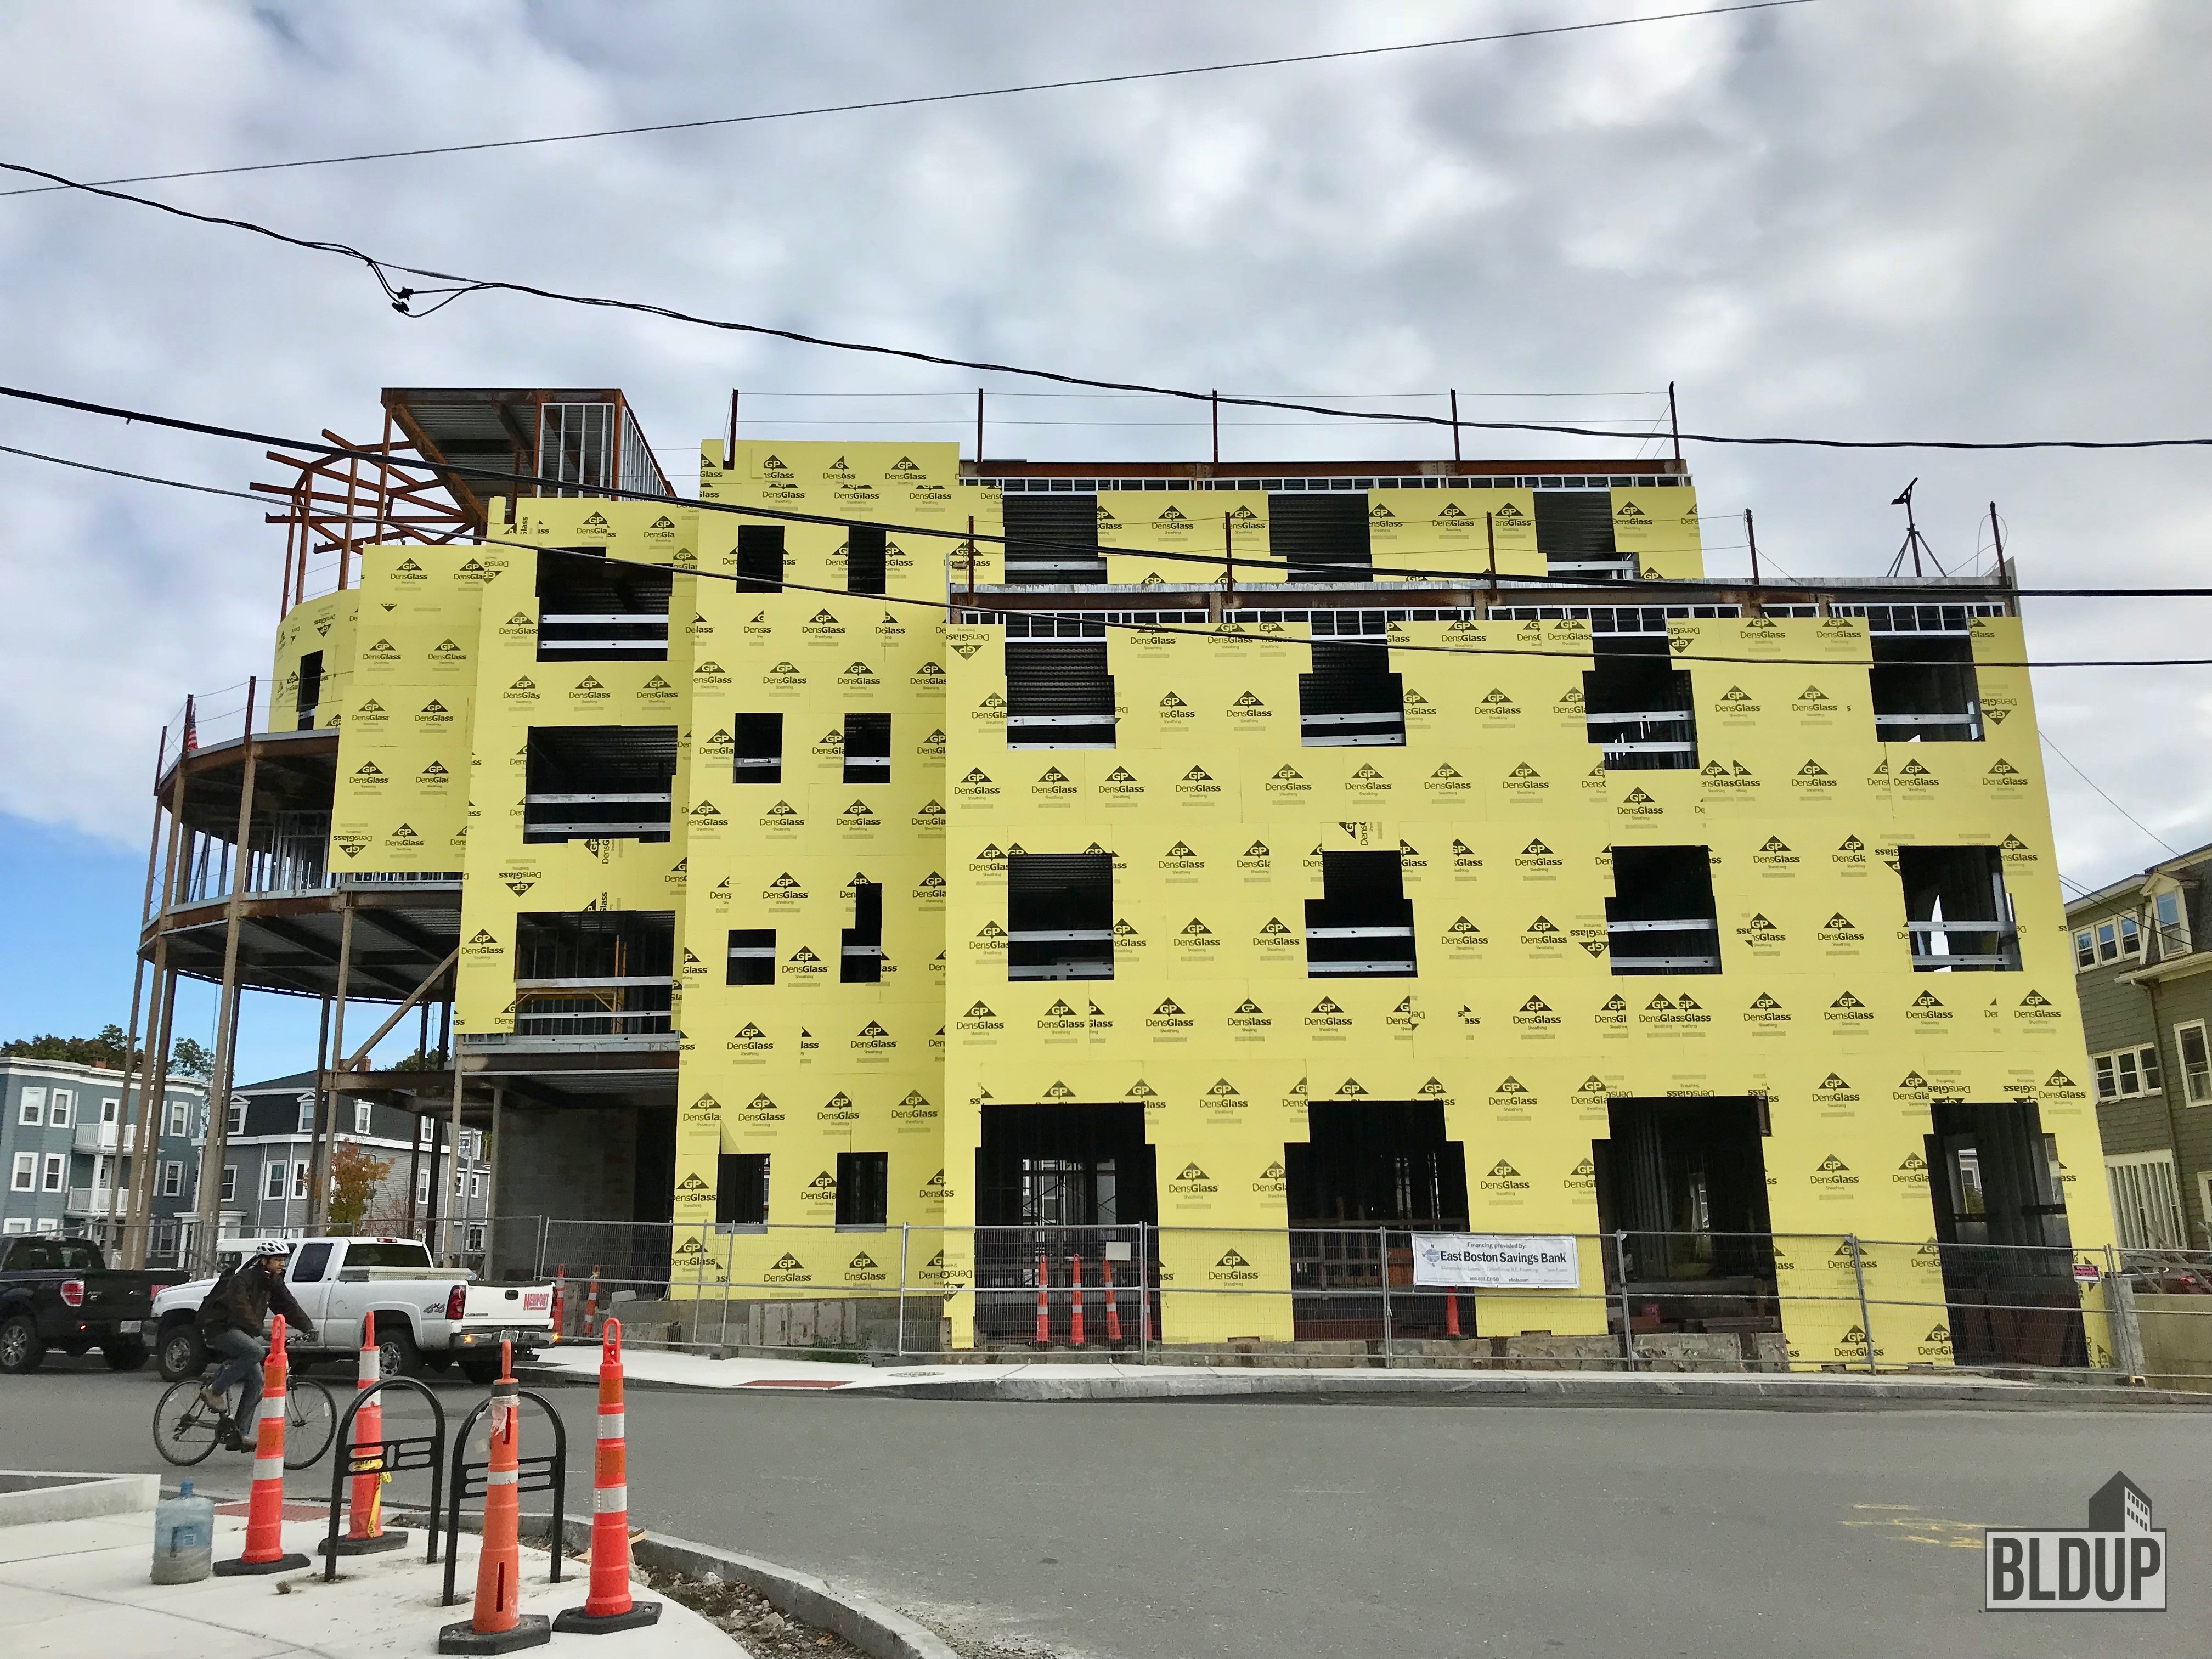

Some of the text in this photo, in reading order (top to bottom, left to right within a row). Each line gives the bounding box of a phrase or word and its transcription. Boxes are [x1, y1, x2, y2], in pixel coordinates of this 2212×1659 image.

[1454, 622, 1470, 630] GP
[1442, 633, 1486, 642] DensGlass
[1515, 768, 1532, 776] GP
[1629, 793, 1647, 802] GP
[1528, 845, 1545, 853] GP
[1266, 924, 1283, 932] GP
[1454, 923, 1471, 931] GP
[1533, 922, 1551, 930] GP
[1756, 999, 1774, 1008] GP
[2025, 996, 2044, 1005] GP
[1051, 1006, 1069, 1014] GP
[1160, 1005, 1177, 1013] GP
[1318, 1003, 1335, 1012] GP
[1526, 1002, 1544, 1011] GP
[970, 1007, 988, 1016] GP
[1906, 1011, 1953, 1019] DensGlass
[1305, 1017, 1352, 1025] DensGlass
[1513, 1015, 1561, 1024] DensGlass
[1743, 1013, 1791, 1021] DensGlass
[957, 1021, 1005, 1029] DensGlass
[1037, 1020, 1085, 1028] DensGlass
[865, 1027, 882, 1035] GP
[2050, 1076, 2068, 1085] GP
[1214, 1085, 1231, 1094] GP
[1502, 1083, 1520, 1091] GP
[1812, 1093, 1860, 1102] DensGlass
[2039, 1091, 2086, 1099] DensGlass
[1200, 1099, 1248, 1108] DensGlass
[1489, 1097, 1538, 1105] DensGlass
[738, 1113, 785, 1121] DensGlass
[891, 1110, 938, 1118] DensGlass
[1183, 1170, 1201, 1178] GP
[1494, 1166, 1512, 1175] GP
[1810, 1175, 1859, 1184] DensGlass
[1169, 1184, 1218, 1193] DensGlass
[1481, 1181, 1530, 1189] DensGlass
[1223, 1256, 1241, 1265] GP
[1441, 1251, 1566, 1265] East Boston Savings Bank
[764, 1273, 812, 1282] DensGlass
[1209, 1271, 1259, 1280] DensGlass
[524, 1293, 550, 1310] NEWPORT
